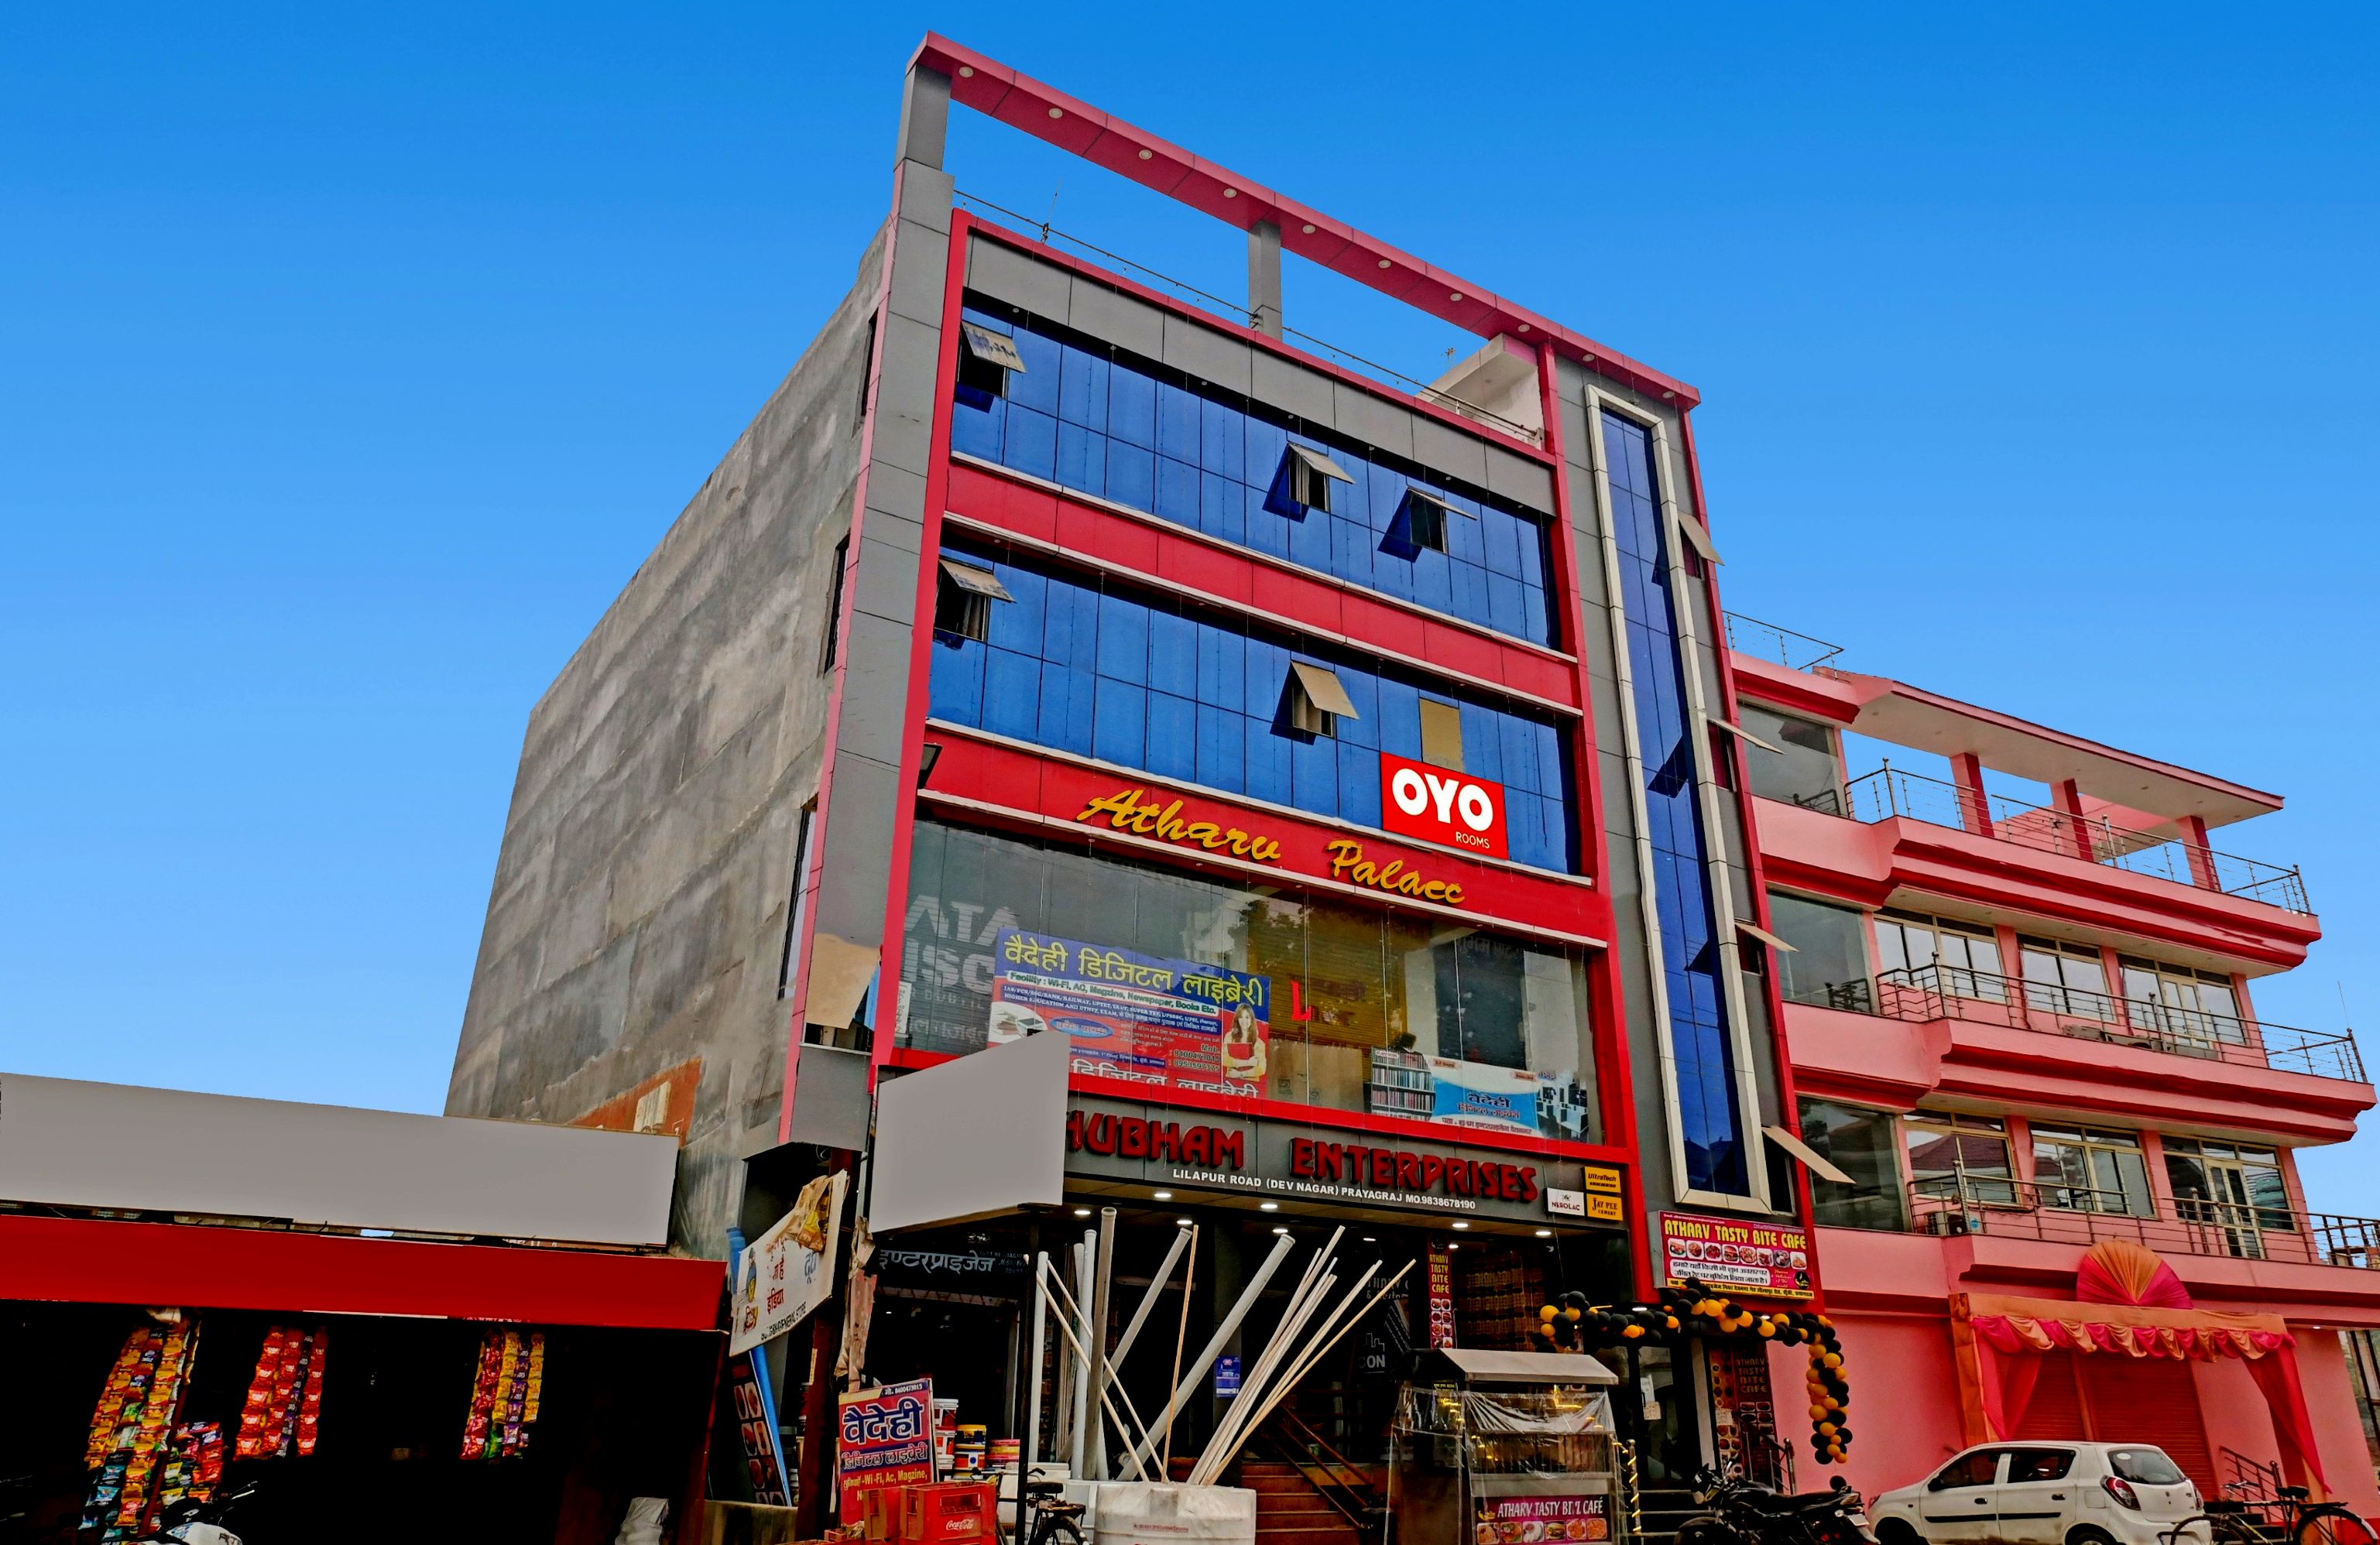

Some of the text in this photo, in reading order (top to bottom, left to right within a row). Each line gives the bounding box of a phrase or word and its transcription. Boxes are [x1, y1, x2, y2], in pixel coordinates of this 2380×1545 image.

[1392, 768, 1494, 831] OYO
[1076, 788, 1281, 860] Atharv
[1456, 831, 1490, 849] ROOMS
[1003, 934, 1264, 1006] वैदेही डिजिटल लाइब्रेरी
[1175, 1001, 1199, 1012] Books
[1291, 1137, 1538, 1202] ENTERPRISES
[1588, 1173, 1617, 1182] UltraTech
[1173, 1169, 1226, 1184] LILAPUR
[1229, 1174, 1262, 1187] ROAD
[1266, 1177, 1294, 1190] (DEV
[1296, 1182, 1339, 1196] NAGAR)
[1341, 1187, 1403, 1202] PRAYAGRAJ
[1551, 1201, 1580, 1211] NEROLAC
[1665, 1219, 1710, 1240] ATHARV
[1715, 1225, 1749, 1244] TASTY
[1753, 1230, 1778, 1247] BITE
[1782, 1233, 1807, 1250] CAFE
[1431, 1264, 1449, 1273] TASTY
[1432, 1275, 1449, 1284] BITE
[1432, 1284, 1449, 1294] CAFE
[842, 1396, 924, 1445] वैदेही
[1497, 1502, 1533, 1518] ATHARV
[1534, 1501, 1560, 1516] TASTY
